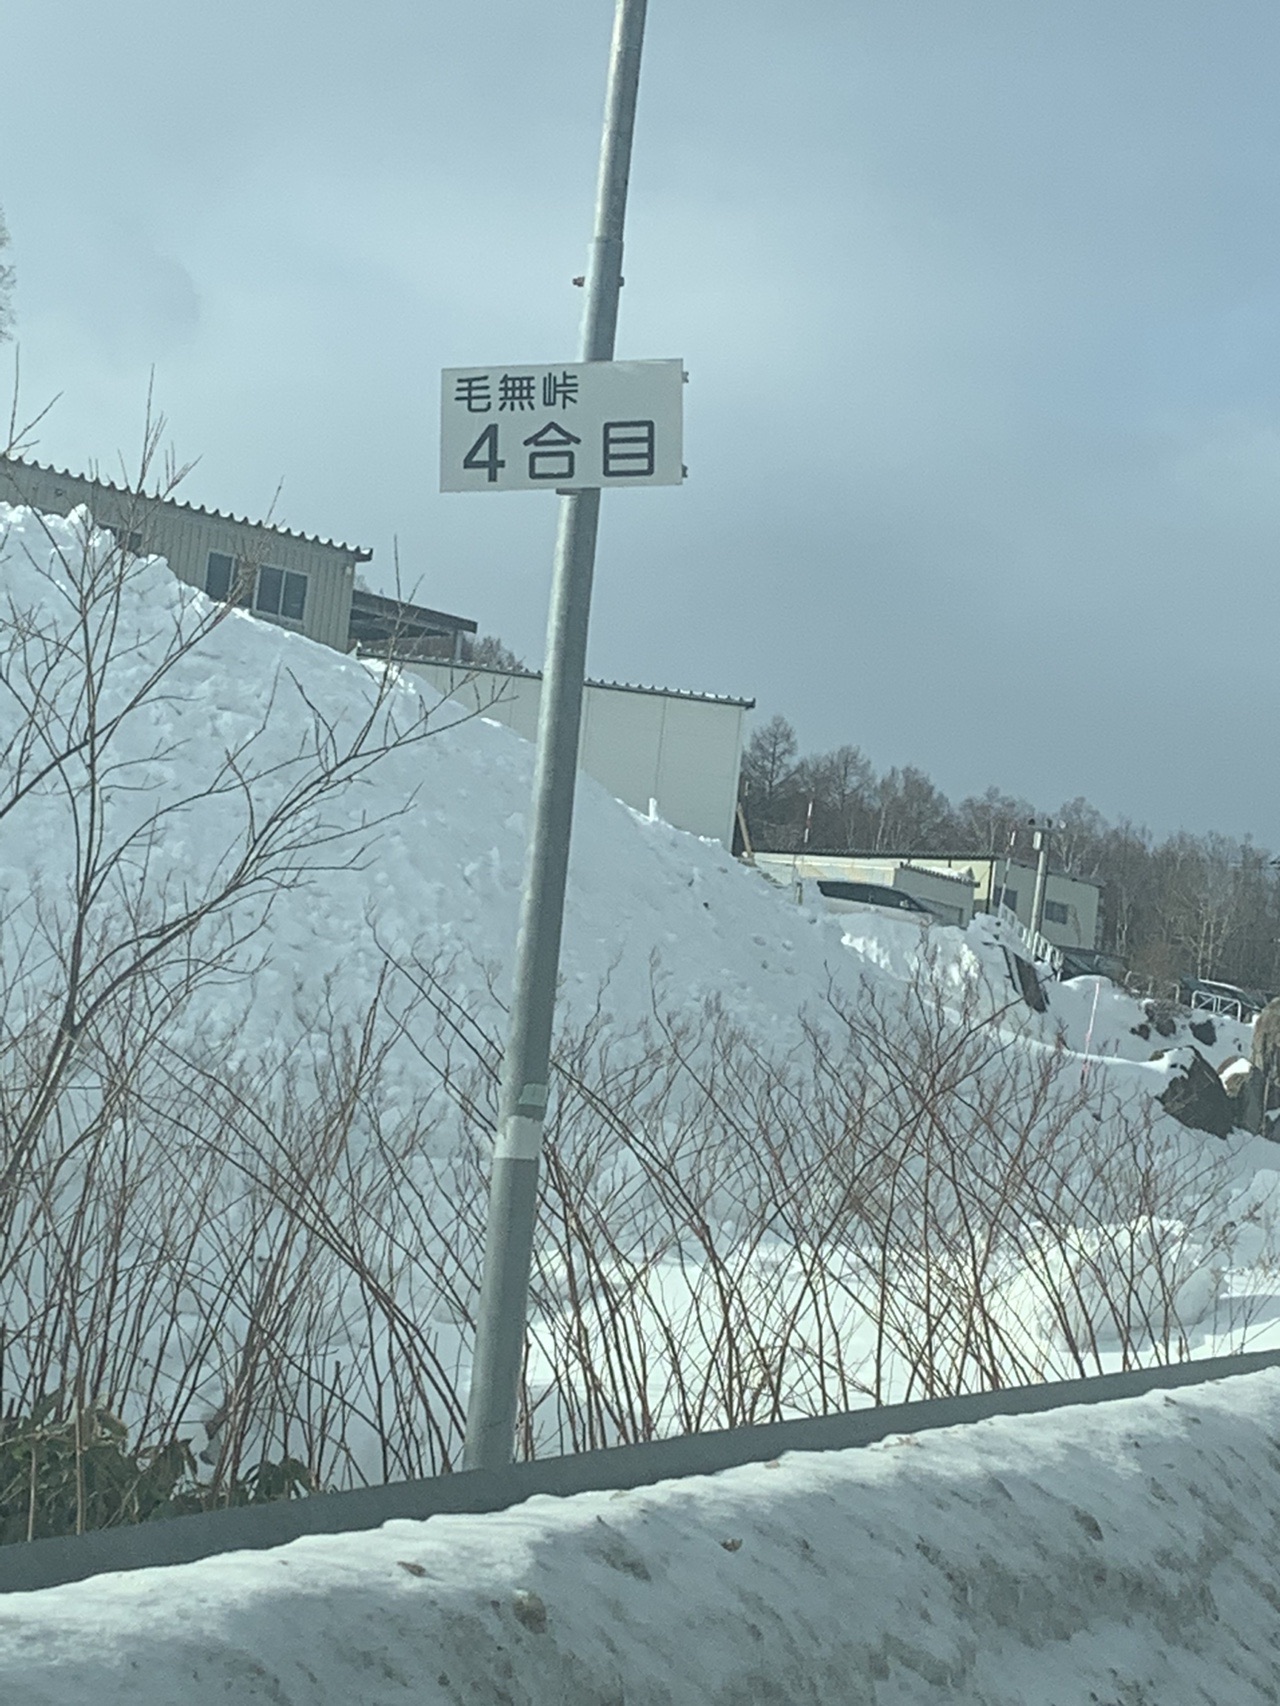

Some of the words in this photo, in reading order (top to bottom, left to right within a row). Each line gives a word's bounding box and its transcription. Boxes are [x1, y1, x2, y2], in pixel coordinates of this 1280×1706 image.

[454, 370, 579, 413] 毛無峠
[463, 420, 655, 483] 4合目
